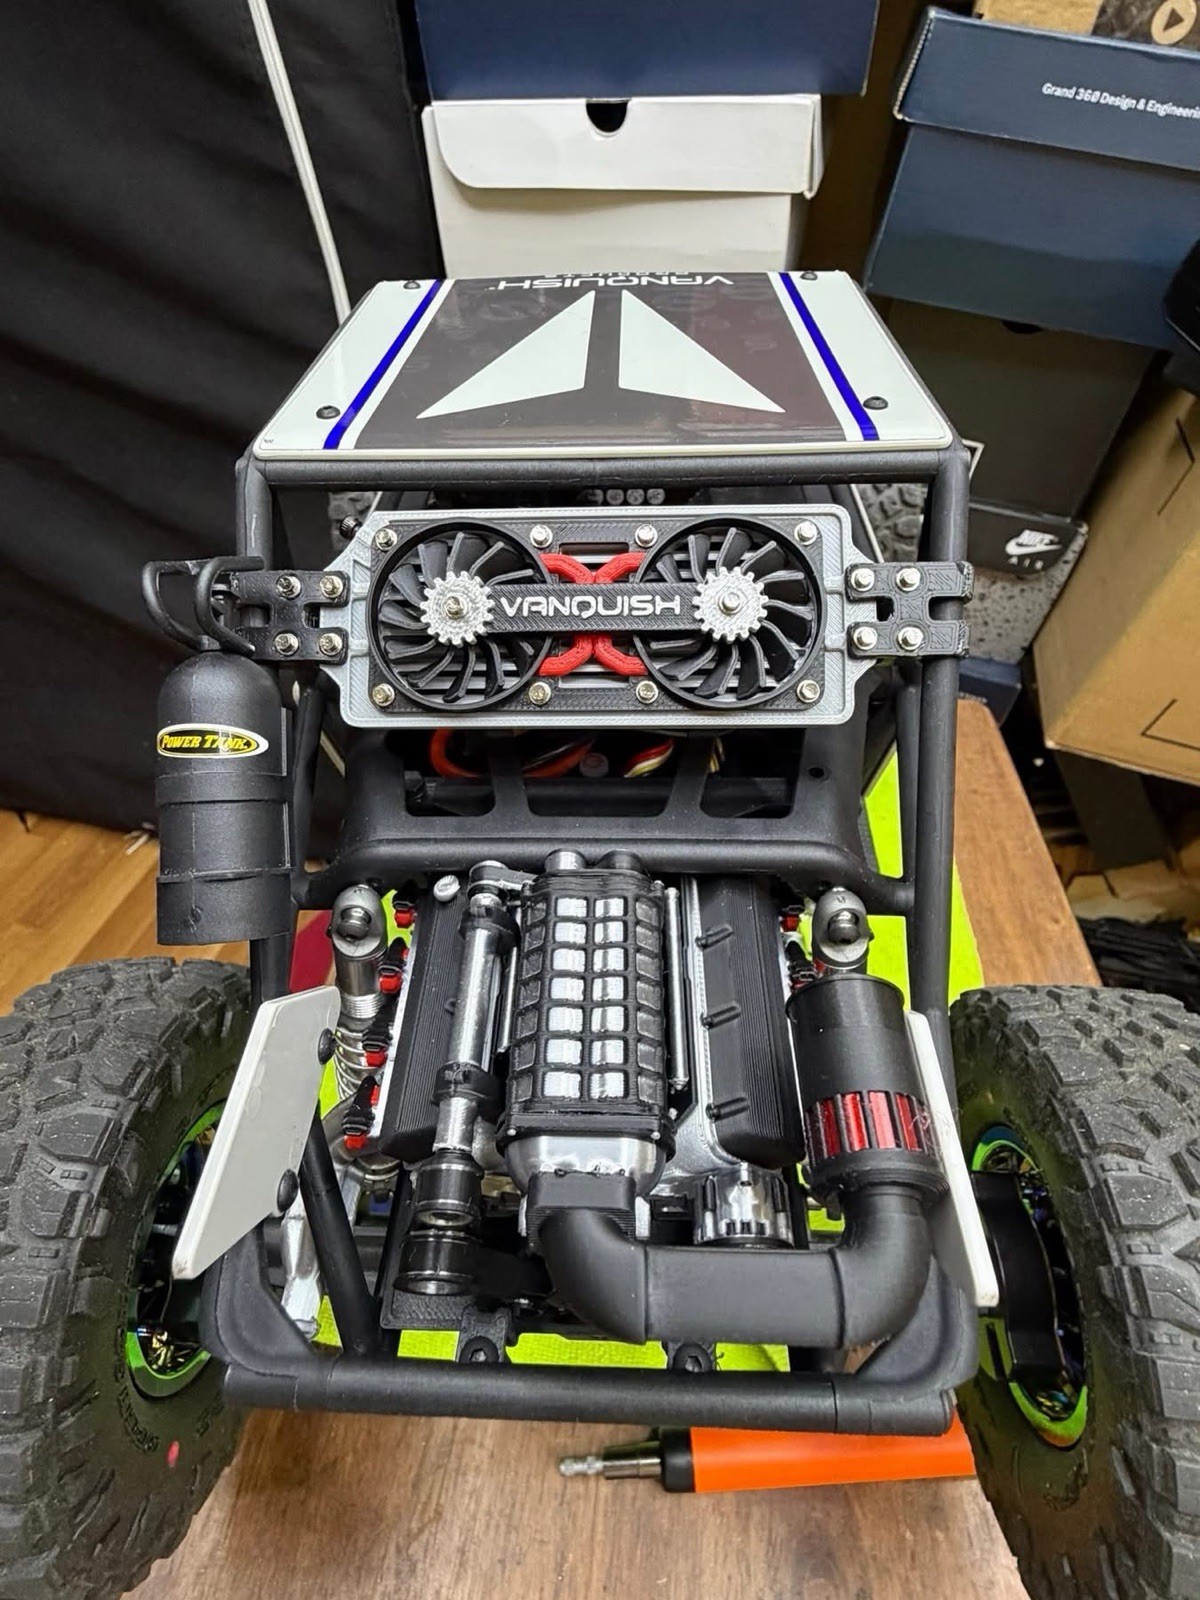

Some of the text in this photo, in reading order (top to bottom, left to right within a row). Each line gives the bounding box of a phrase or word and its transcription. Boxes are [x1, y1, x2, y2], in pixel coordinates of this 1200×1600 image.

[1042, 82, 1200, 119] Grand 360 Design & Engineeri
[498, 275, 734, 290] VANQUISH
[501, 595, 681, 619] VANQUISH
[162, 735, 202, 748] POWER
